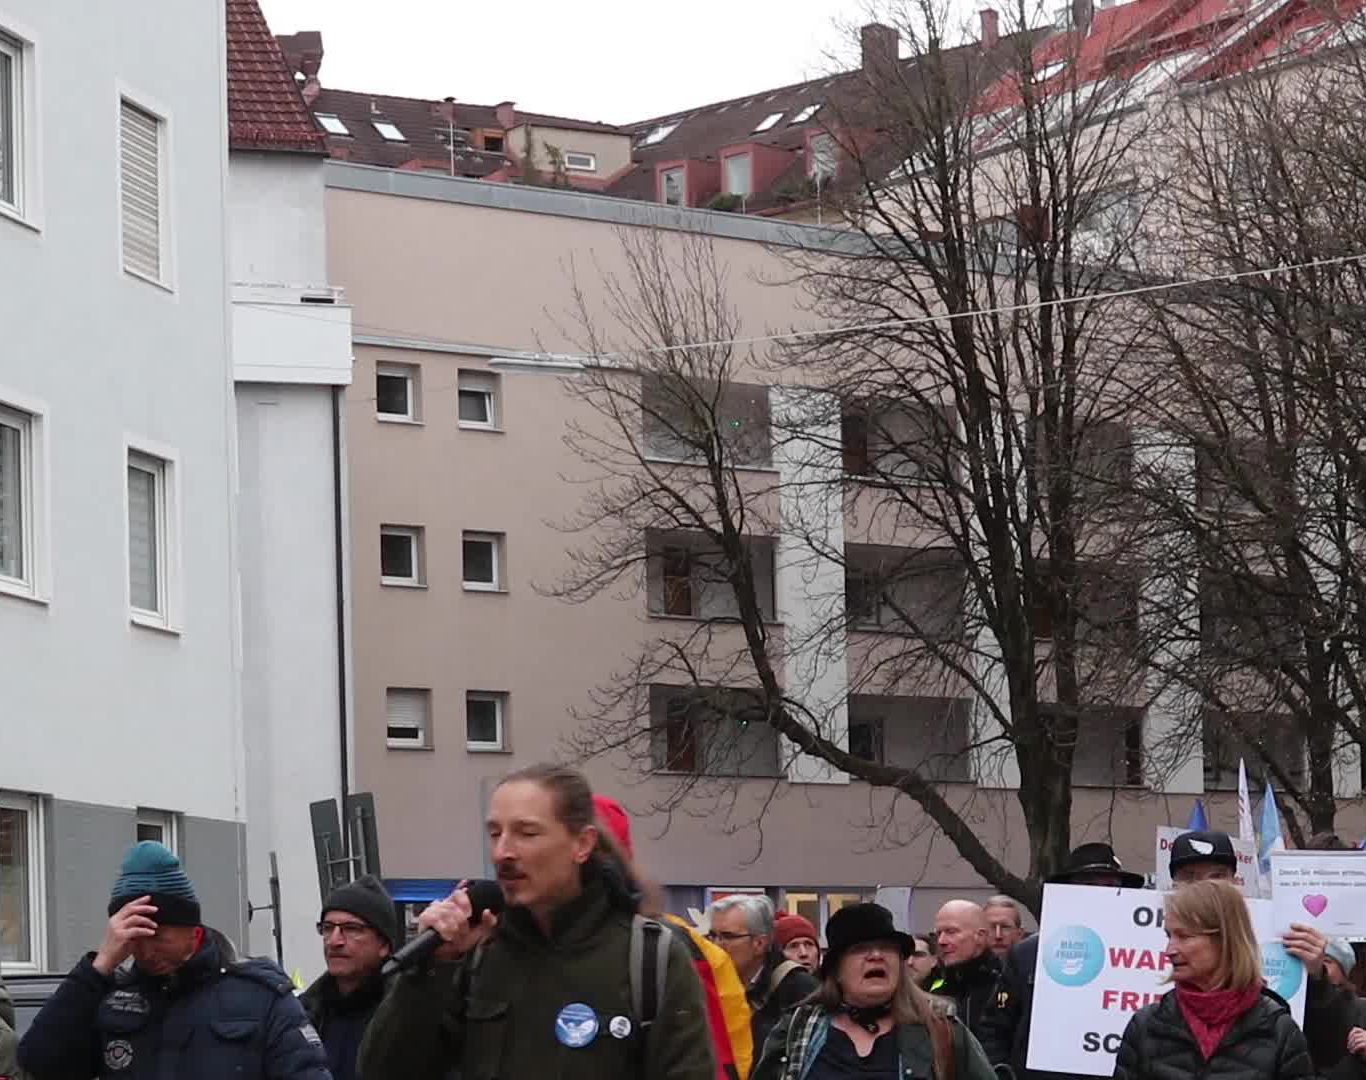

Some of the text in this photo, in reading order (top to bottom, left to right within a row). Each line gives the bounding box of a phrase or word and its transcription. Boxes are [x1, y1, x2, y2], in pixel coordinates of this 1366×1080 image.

[1109, 947, 1173, 971] WAF
[1102, 990, 1162, 1012] FRI
[1083, 1032, 1123, 1054] SC
